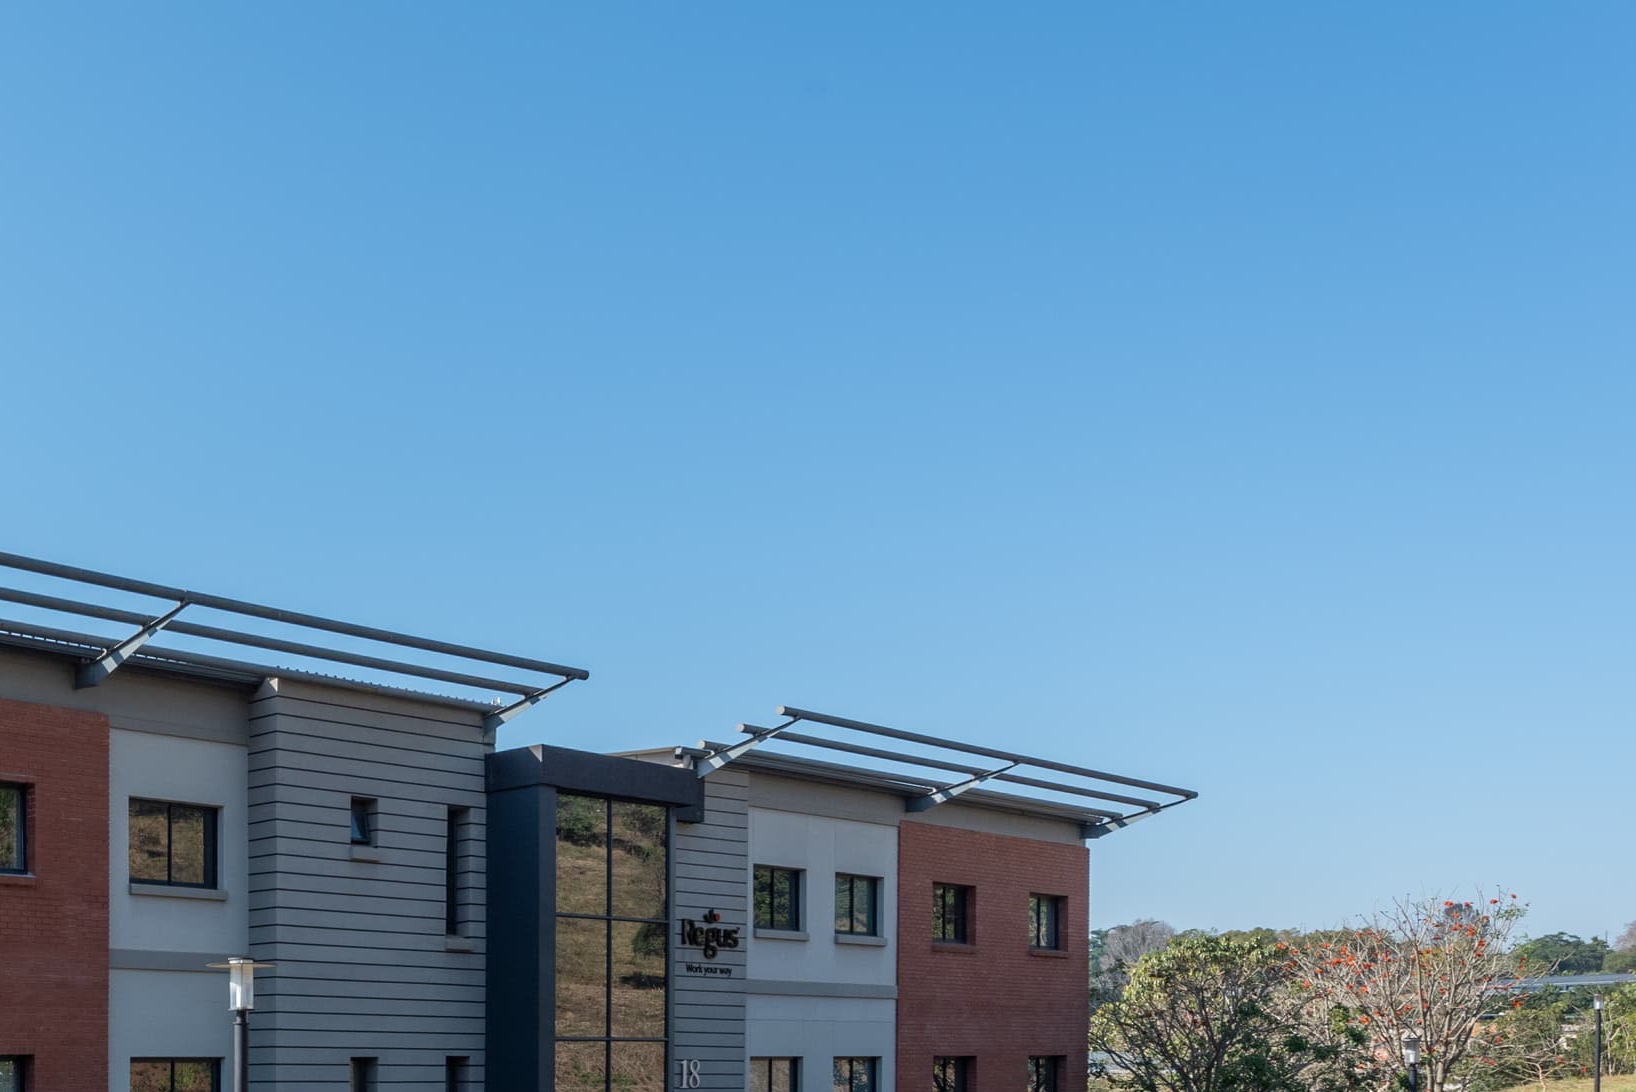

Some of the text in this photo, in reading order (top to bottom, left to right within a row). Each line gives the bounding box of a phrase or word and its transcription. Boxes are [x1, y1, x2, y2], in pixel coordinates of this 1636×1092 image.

[681, 919, 739, 959] Regus
[686, 964, 733, 977] Work your way
[678, 1059, 701, 1089] 18
